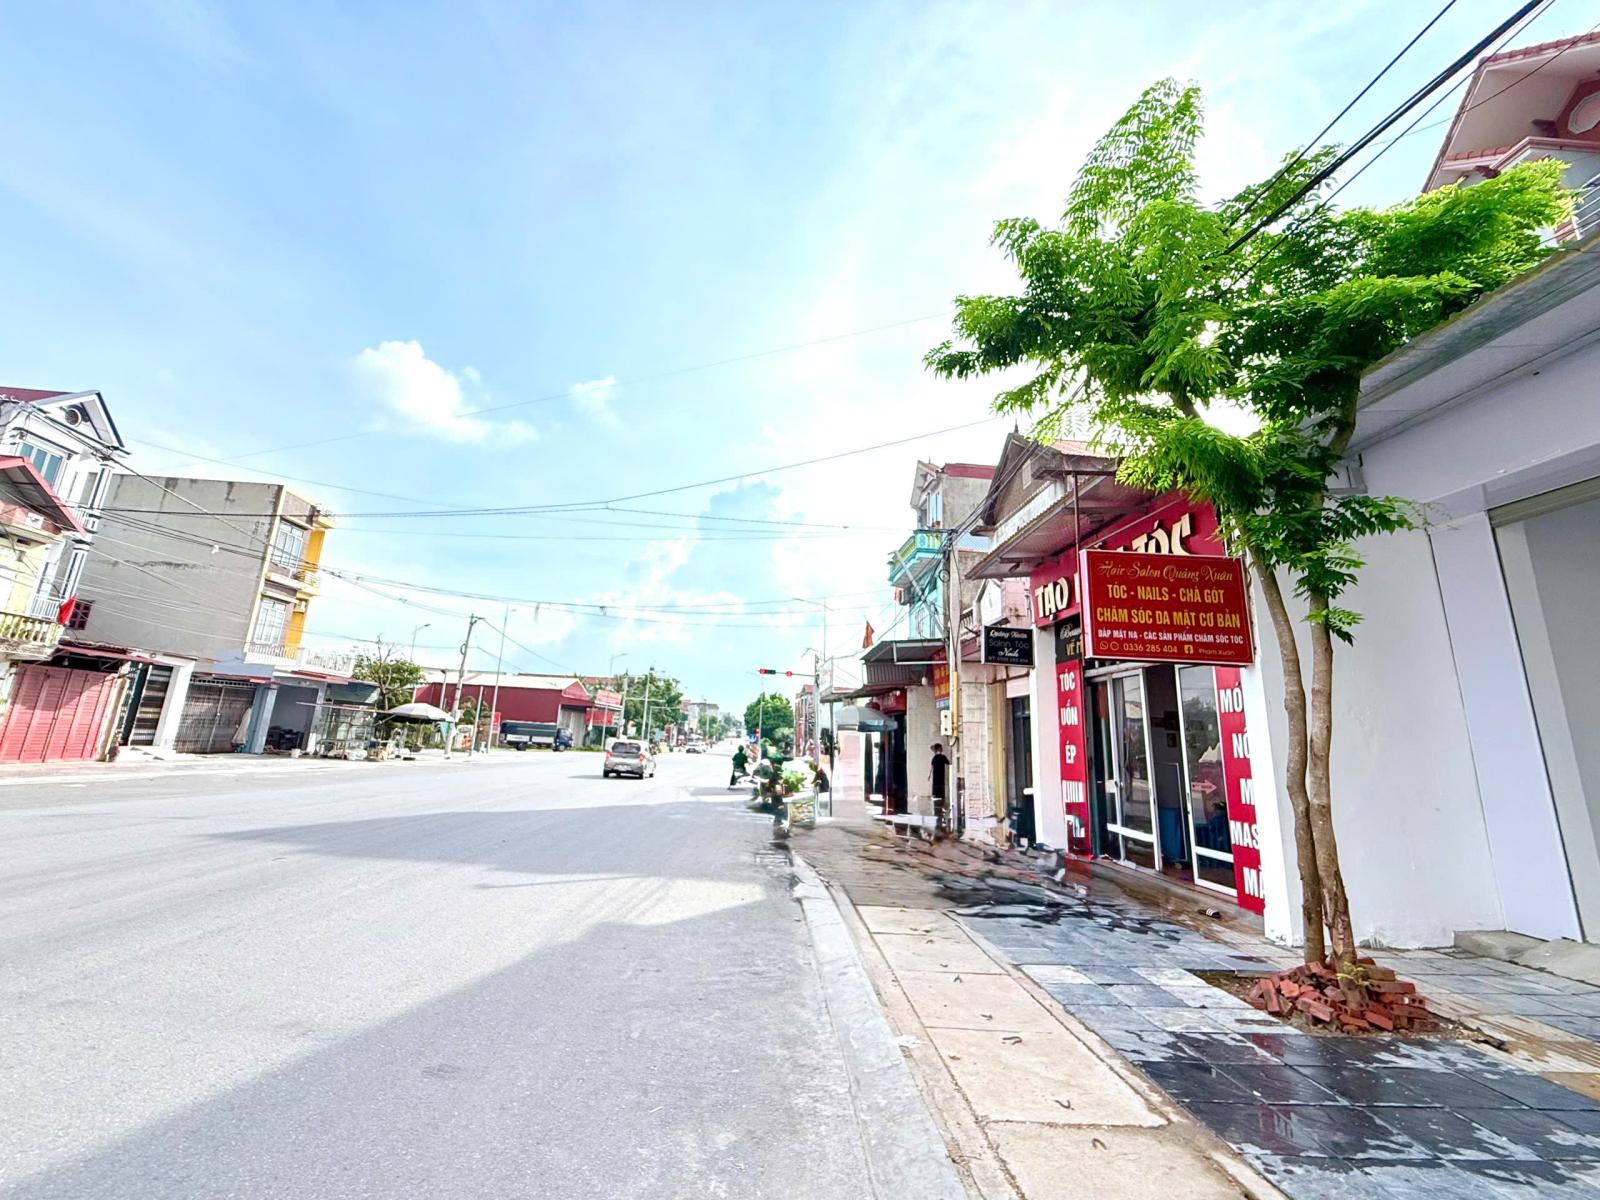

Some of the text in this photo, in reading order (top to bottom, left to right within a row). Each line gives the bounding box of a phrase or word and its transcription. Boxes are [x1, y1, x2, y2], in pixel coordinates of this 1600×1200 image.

[1097, 561, 1125, 578] Hair
[1127, 562, 1161, 579] Salon
[1035, 577, 1069, 621] TẠO
[1107, 581, 1127, 599] TÓC
[1137, 586, 1169, 601] NAILS
[1096, 605, 1240, 630] CHĂM SÓC DA MẶT CƠ BẢN
[989, 638, 1029, 649] Salon Tóc
[1123, 643, 1144, 651] 0336
[1146, 644, 1160, 652] 285
[1163, 645, 1178, 653] 404
[1144, 630, 1157, 640] CÁC
[1216, 632, 1229, 644] SÓC
[1059, 668, 1076, 692] TÓC
[1060, 699, 1078, 726] UỐN
[1065, 740, 1077, 764] ÉP
